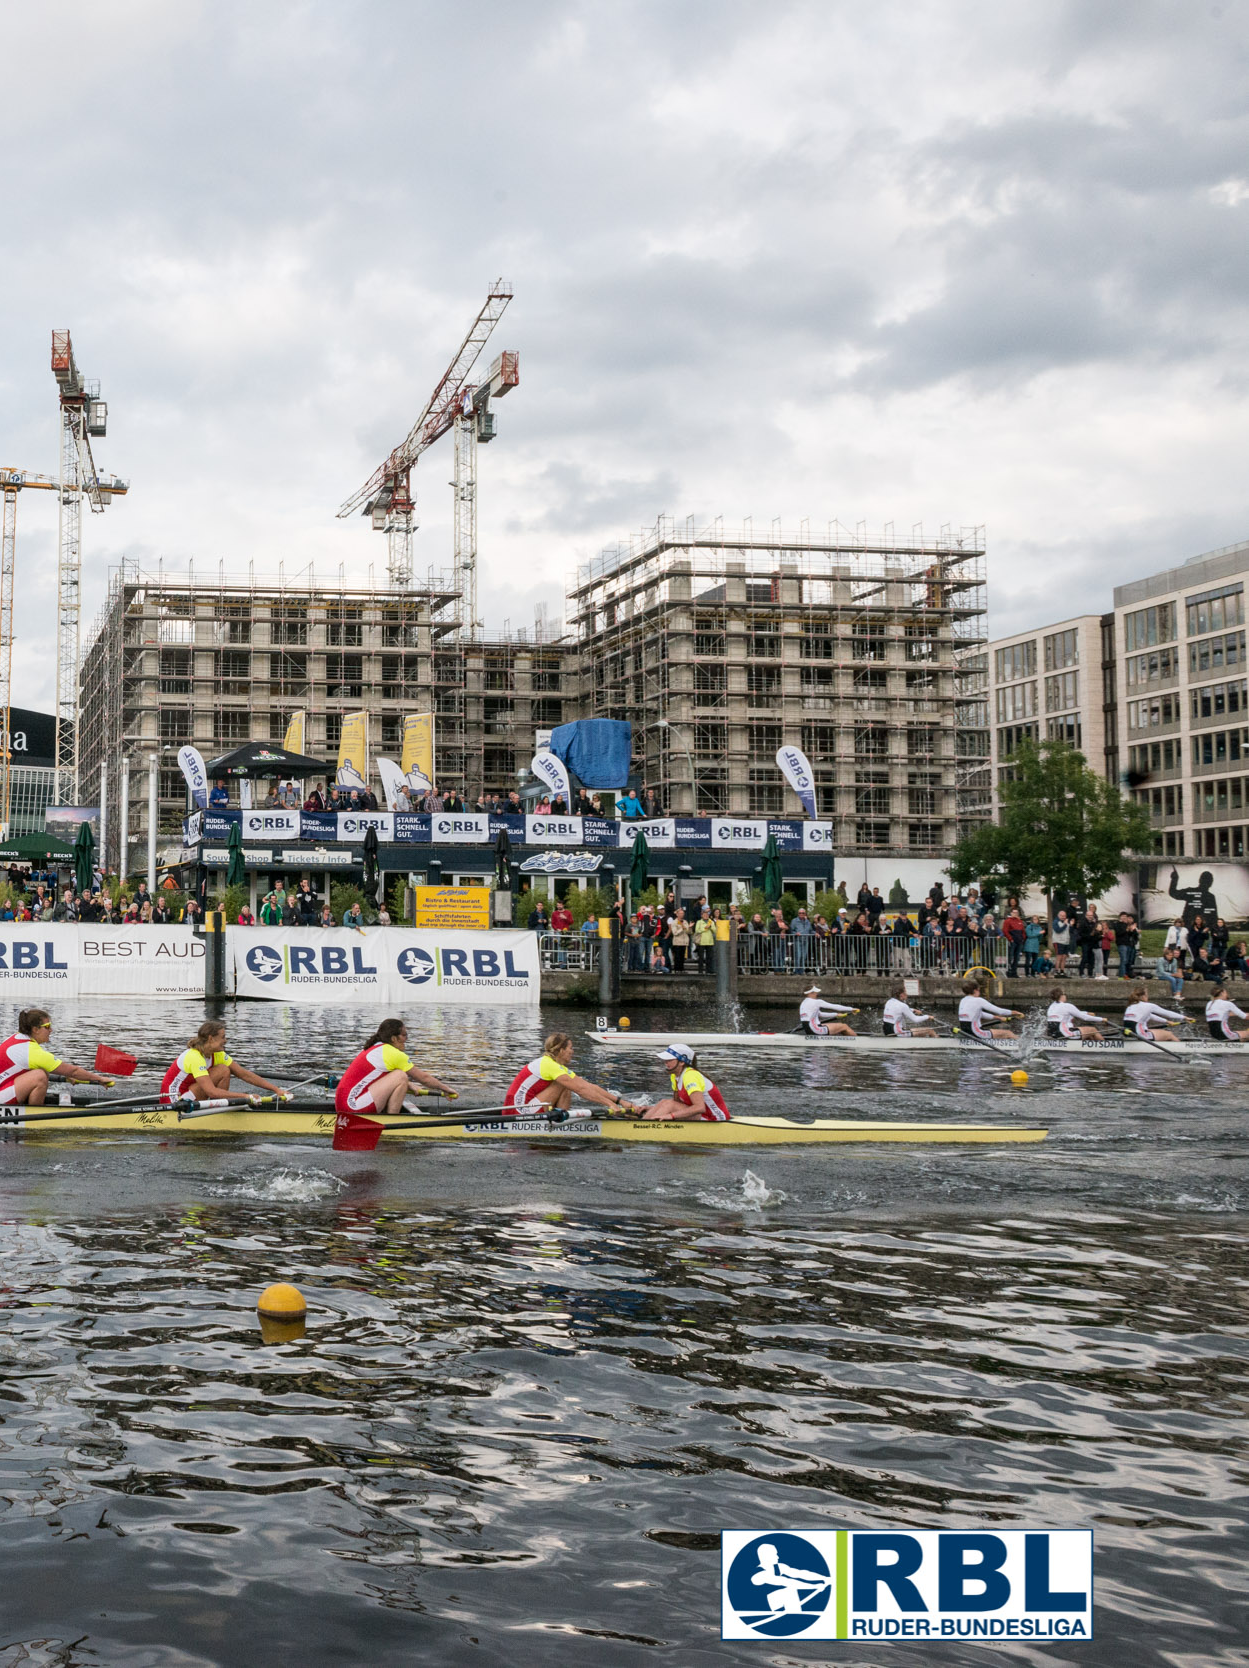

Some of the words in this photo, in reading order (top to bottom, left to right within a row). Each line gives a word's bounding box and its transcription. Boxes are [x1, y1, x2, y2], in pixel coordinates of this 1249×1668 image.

[264, 818, 295, 829] RBL
[396, 824, 430, 832] SCHNELL.
[453, 822, 483, 832] RBL
[548, 823, 578, 834] RBL
[769, 824, 793, 832] STARK.
[584, 828, 617, 836] SCHNELL.
[732, 827, 762, 838] RBL
[287, 855, 320, 864] Tickets
[328, 856, 348, 864] Info
[84, 941, 148, 957] BEST
[155, 942, 206, 958] AUD
[290, 946, 378, 975] RBL
[441, 948, 530, 978] RBL
[290, 976, 378, 984] RUDER-BUNDESLIGA
[443, 978, 530, 988] RUDER-BUNDESLIGA
[598, 1017, 606, 1027] 8
[1082, 1040, 1125, 1049] POTSDAM
[134, 1112, 164, 1125] Melitta
